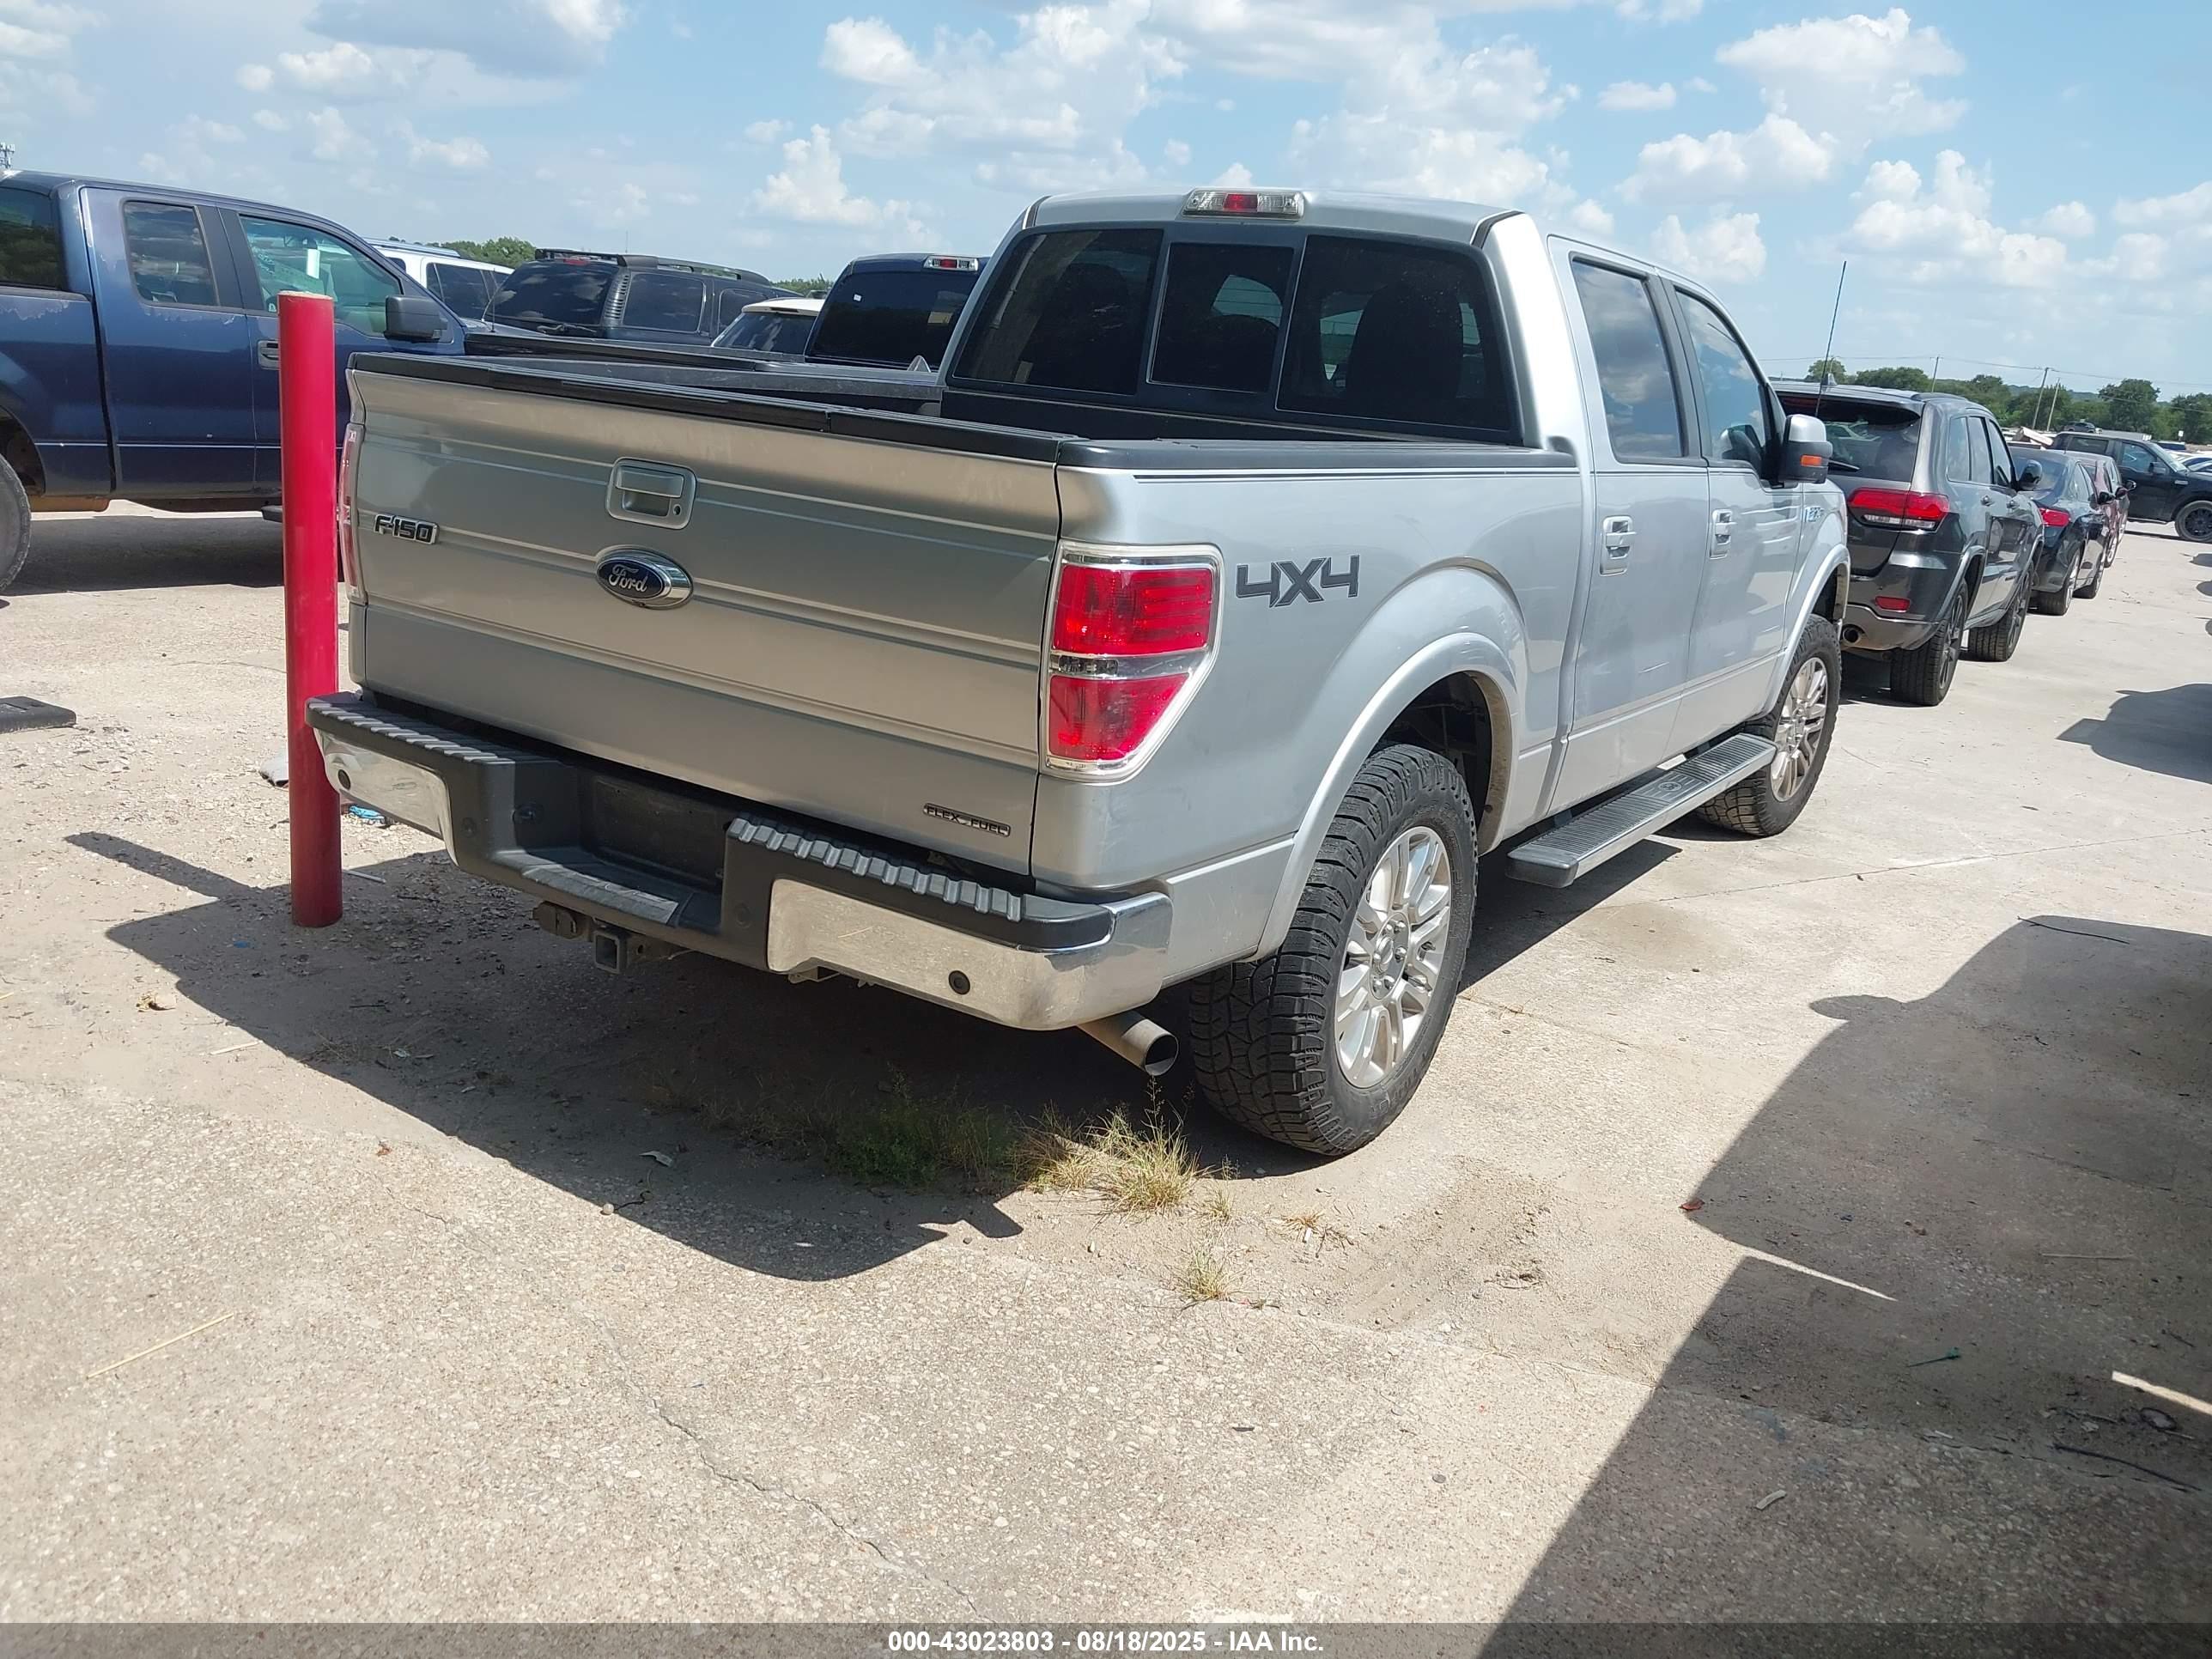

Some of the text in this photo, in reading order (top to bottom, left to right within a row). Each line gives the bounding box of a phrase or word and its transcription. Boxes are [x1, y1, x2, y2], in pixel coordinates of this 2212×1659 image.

[374, 514, 436, 544] F-150
[608, 563, 649, 592] Ford
[1236, 554, 1360, 608] 4X4
[925, 805, 1010, 836] FLEX FUEL
